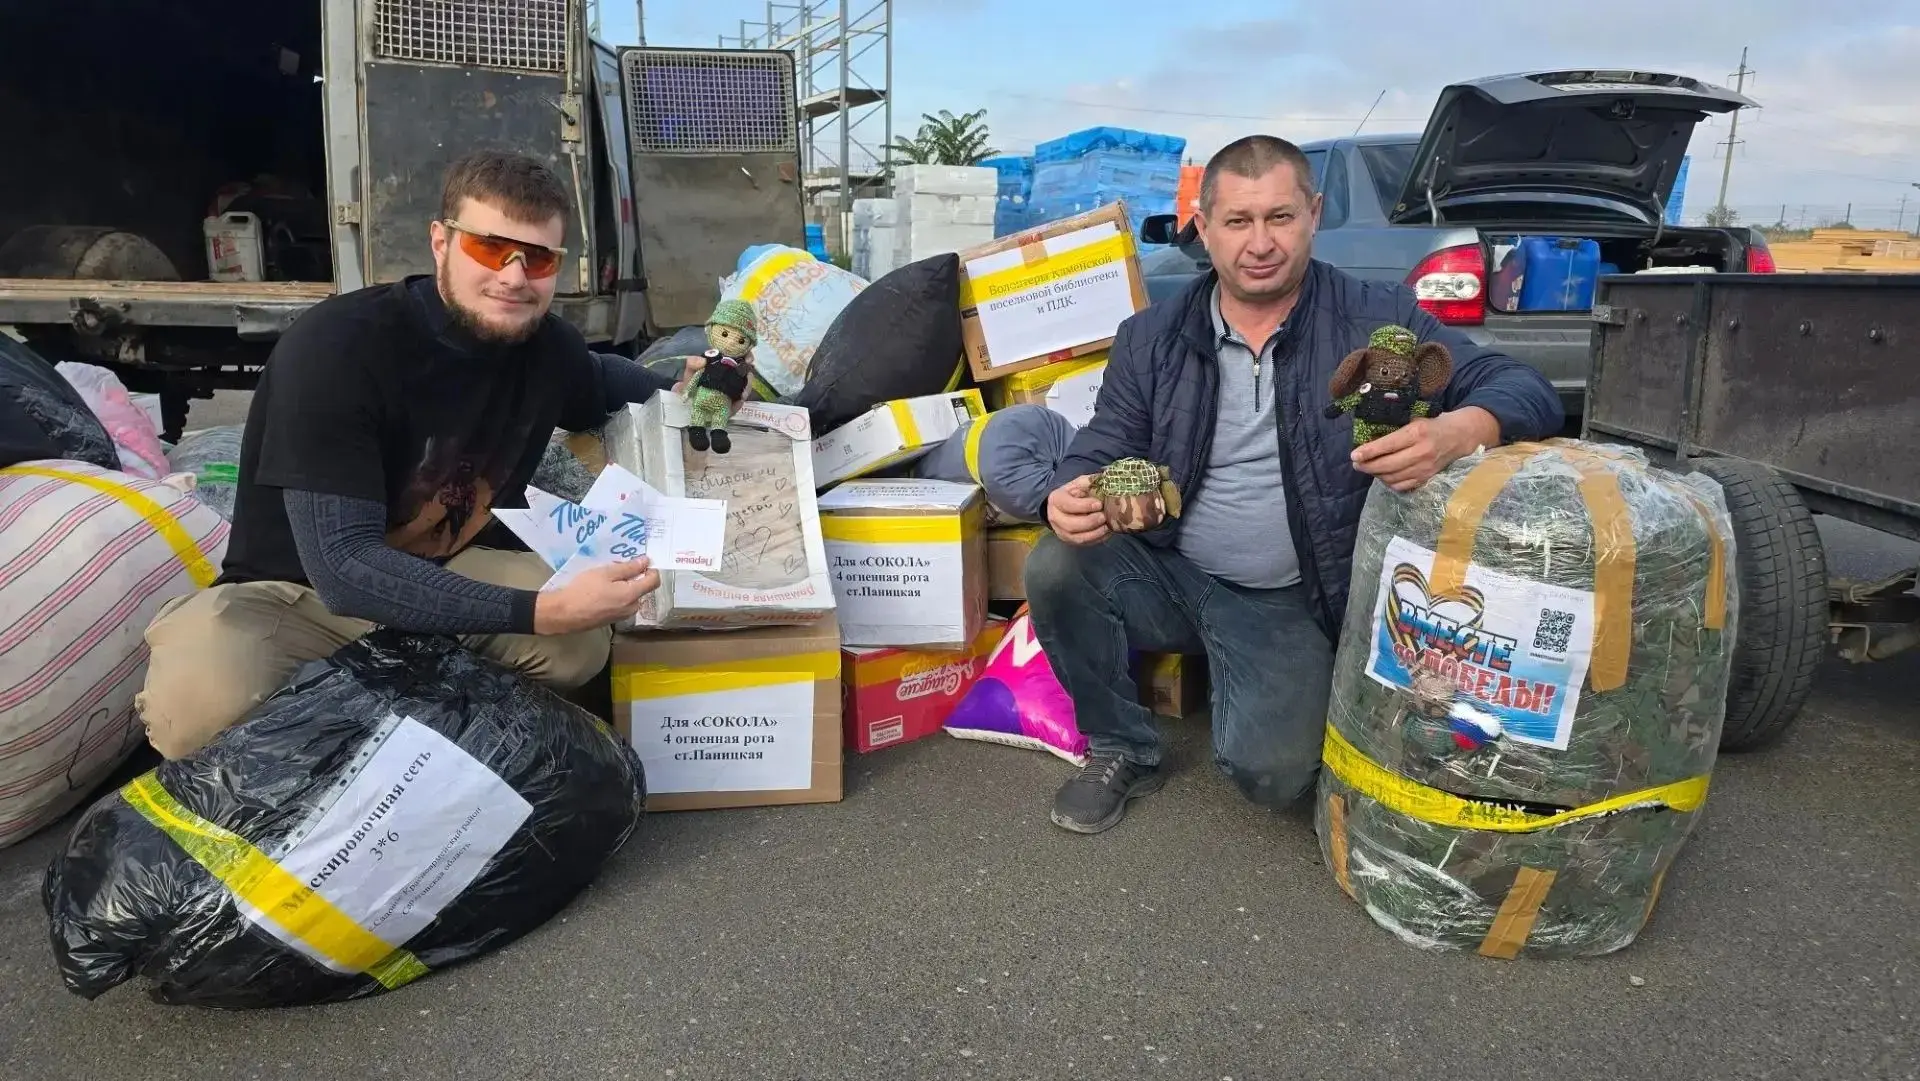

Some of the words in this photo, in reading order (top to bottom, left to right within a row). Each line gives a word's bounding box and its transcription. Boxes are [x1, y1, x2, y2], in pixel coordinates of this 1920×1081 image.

[990, 287, 1052, 311] поселковой
[1053, 269, 1119, 293] библиотеки
[1037, 305, 1045, 314] и
[1047, 295, 1078, 313] ПДК.
[833, 556, 856, 568] Для
[859, 556, 930, 568] «СОКОЛА»
[836, 571, 843, 581] 4
[846, 573, 899, 582] огненная
[903, 573, 930, 584] рота
[846, 587, 921, 598] ст.Паницкая
[1423, 648, 1557, 715] ПОБЕДЫ!
[660, 716, 689, 728] Для
[693, 715, 778, 728] «СОКОЛА»
[663, 733, 671, 744] 4
[675, 735, 739, 744] огненная
[743, 734, 775, 746] рота
[674, 750, 763, 761] ст.Паницкая
[281, 783, 405, 914] Маскировочная
[402, 751, 432, 782] сеть
